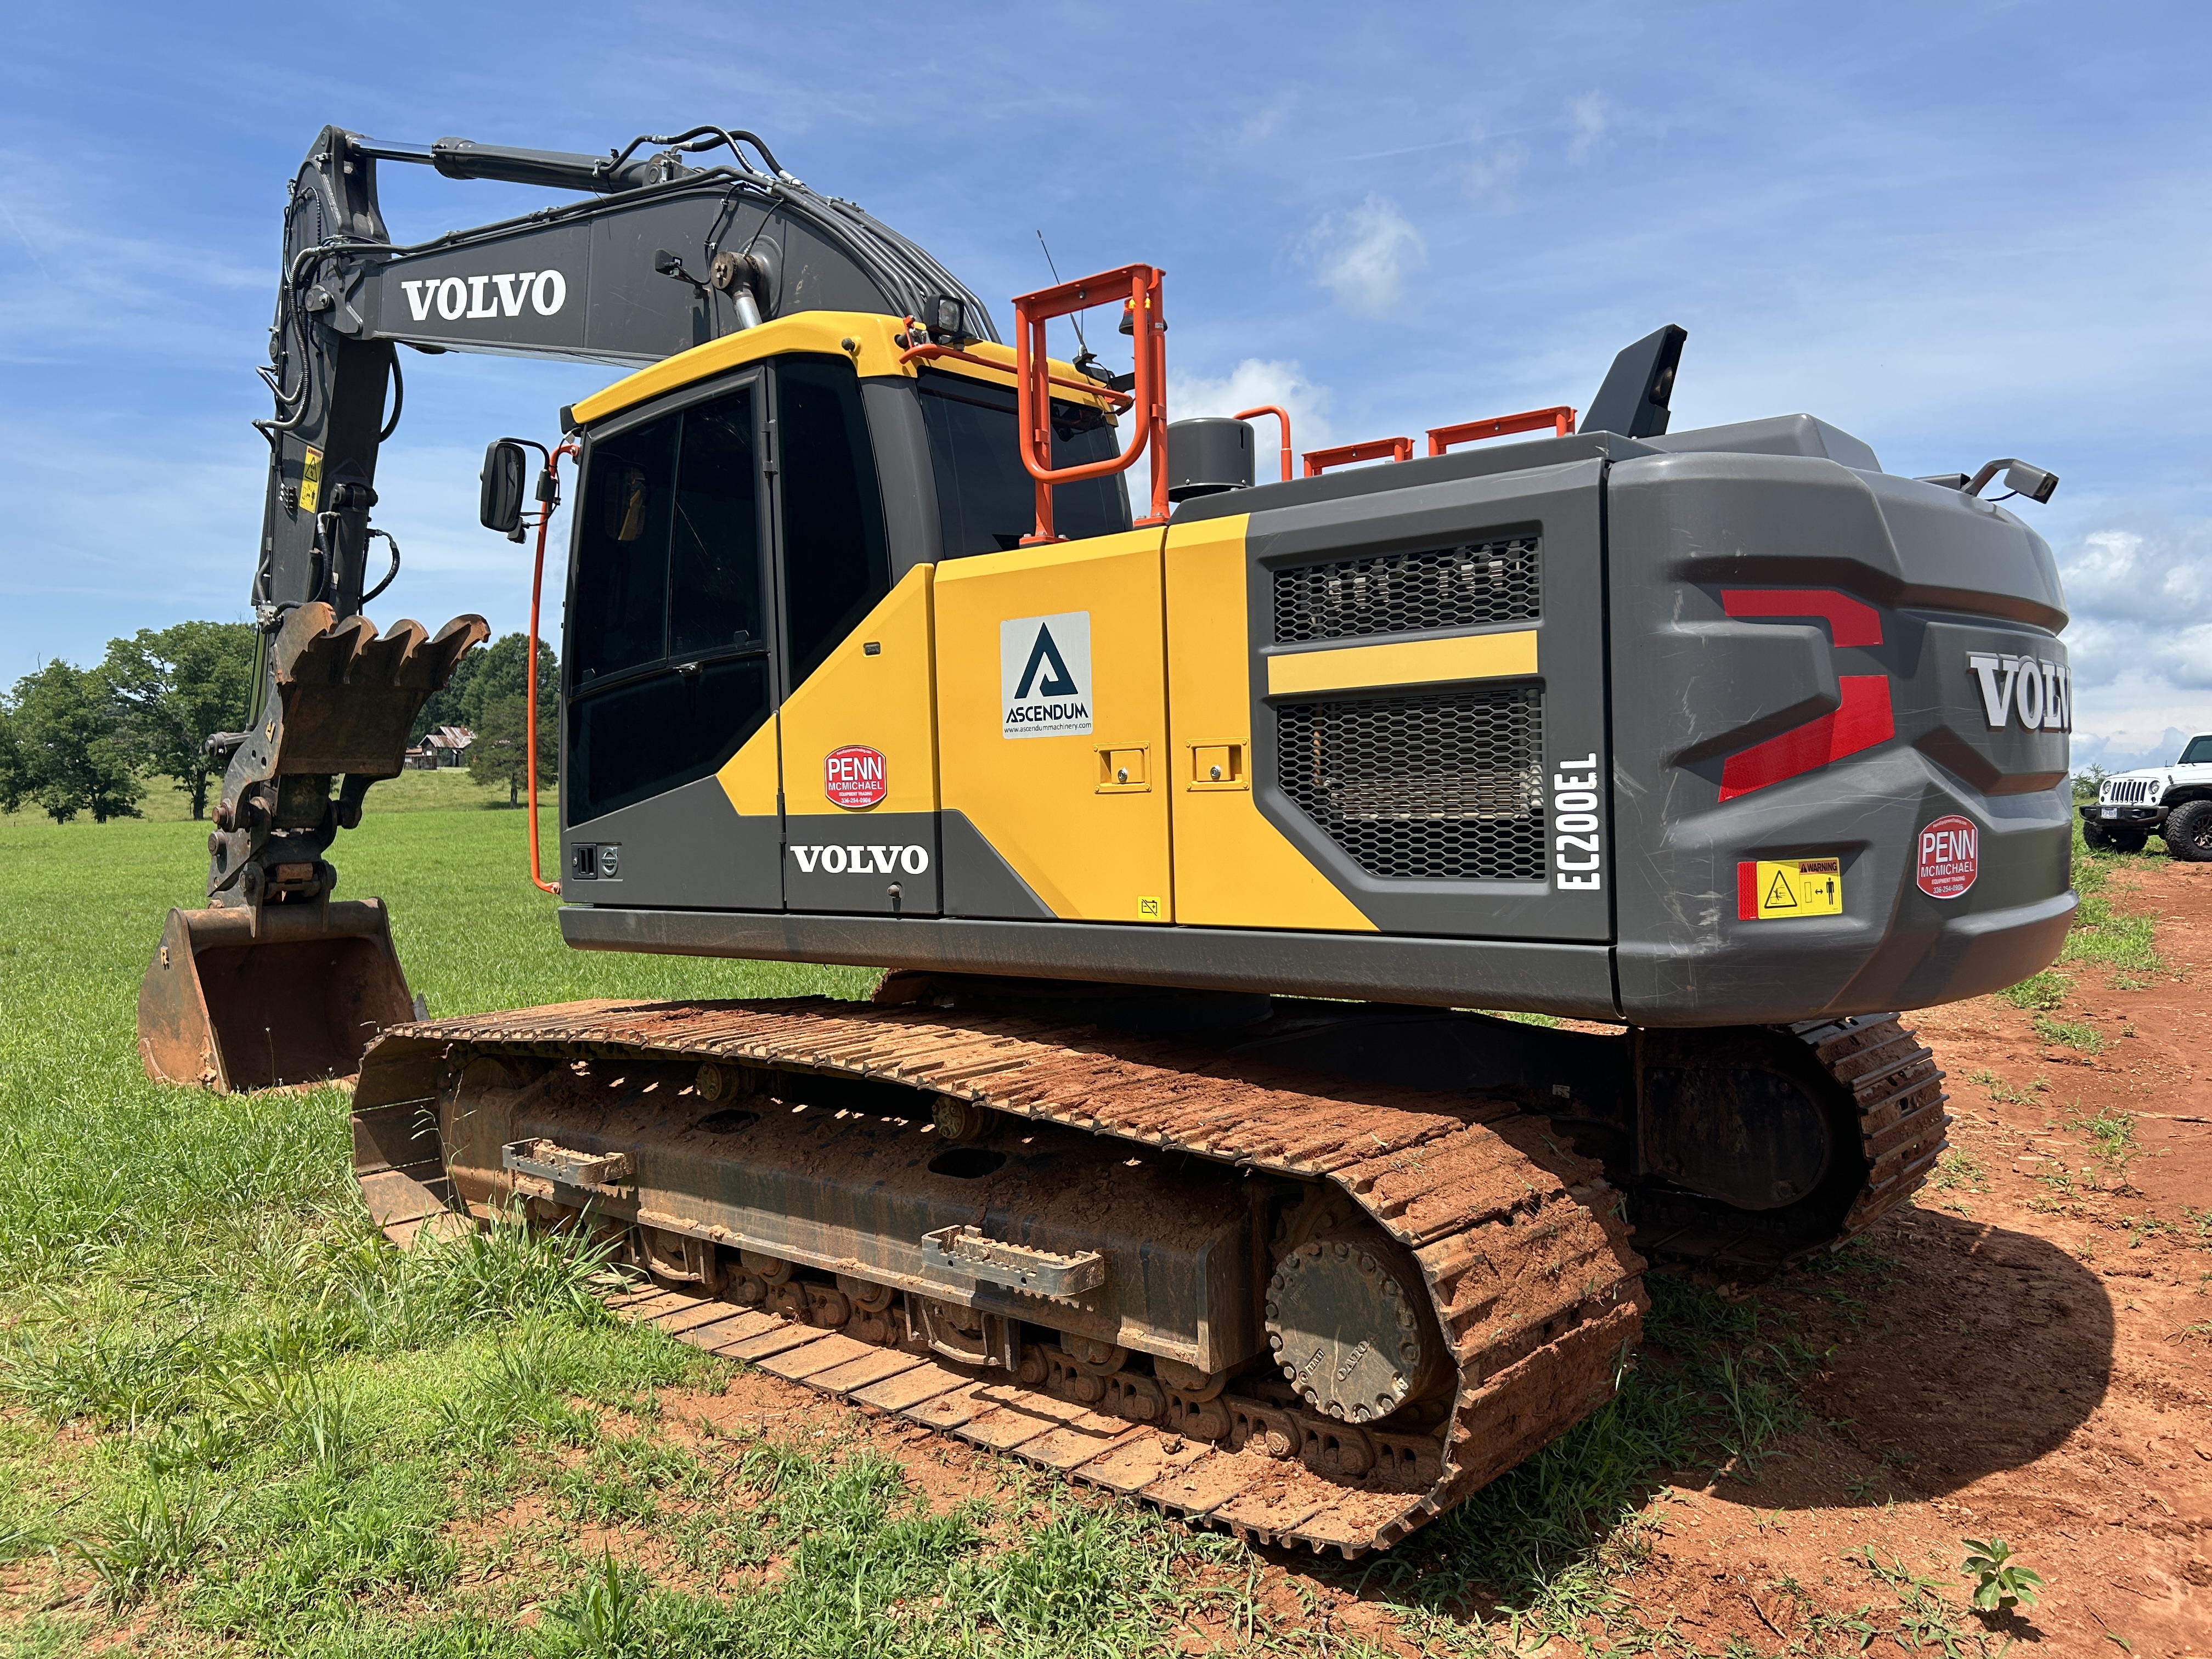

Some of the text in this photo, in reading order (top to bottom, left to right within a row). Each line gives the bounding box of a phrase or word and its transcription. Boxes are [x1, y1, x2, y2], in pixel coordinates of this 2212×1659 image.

[401, 269, 566, 321] VOLVO
[1967, 652, 2072, 733] VOLV
[1006, 702, 1088, 723] ASCENDUM
[1005, 723, 1091, 733] www.ascendummachinery.com
[828, 757, 882, 781] PENN
[828, 781, 883, 791] MCMICHAEL
[1554, 753, 1600, 890] EC200EL
[1922, 828, 1975, 865] PENN
[790, 845, 929, 874] VOLVO
[1807, 862, 1837, 872] WARNING
[1921, 861, 1974, 878] MCMICHAEL
